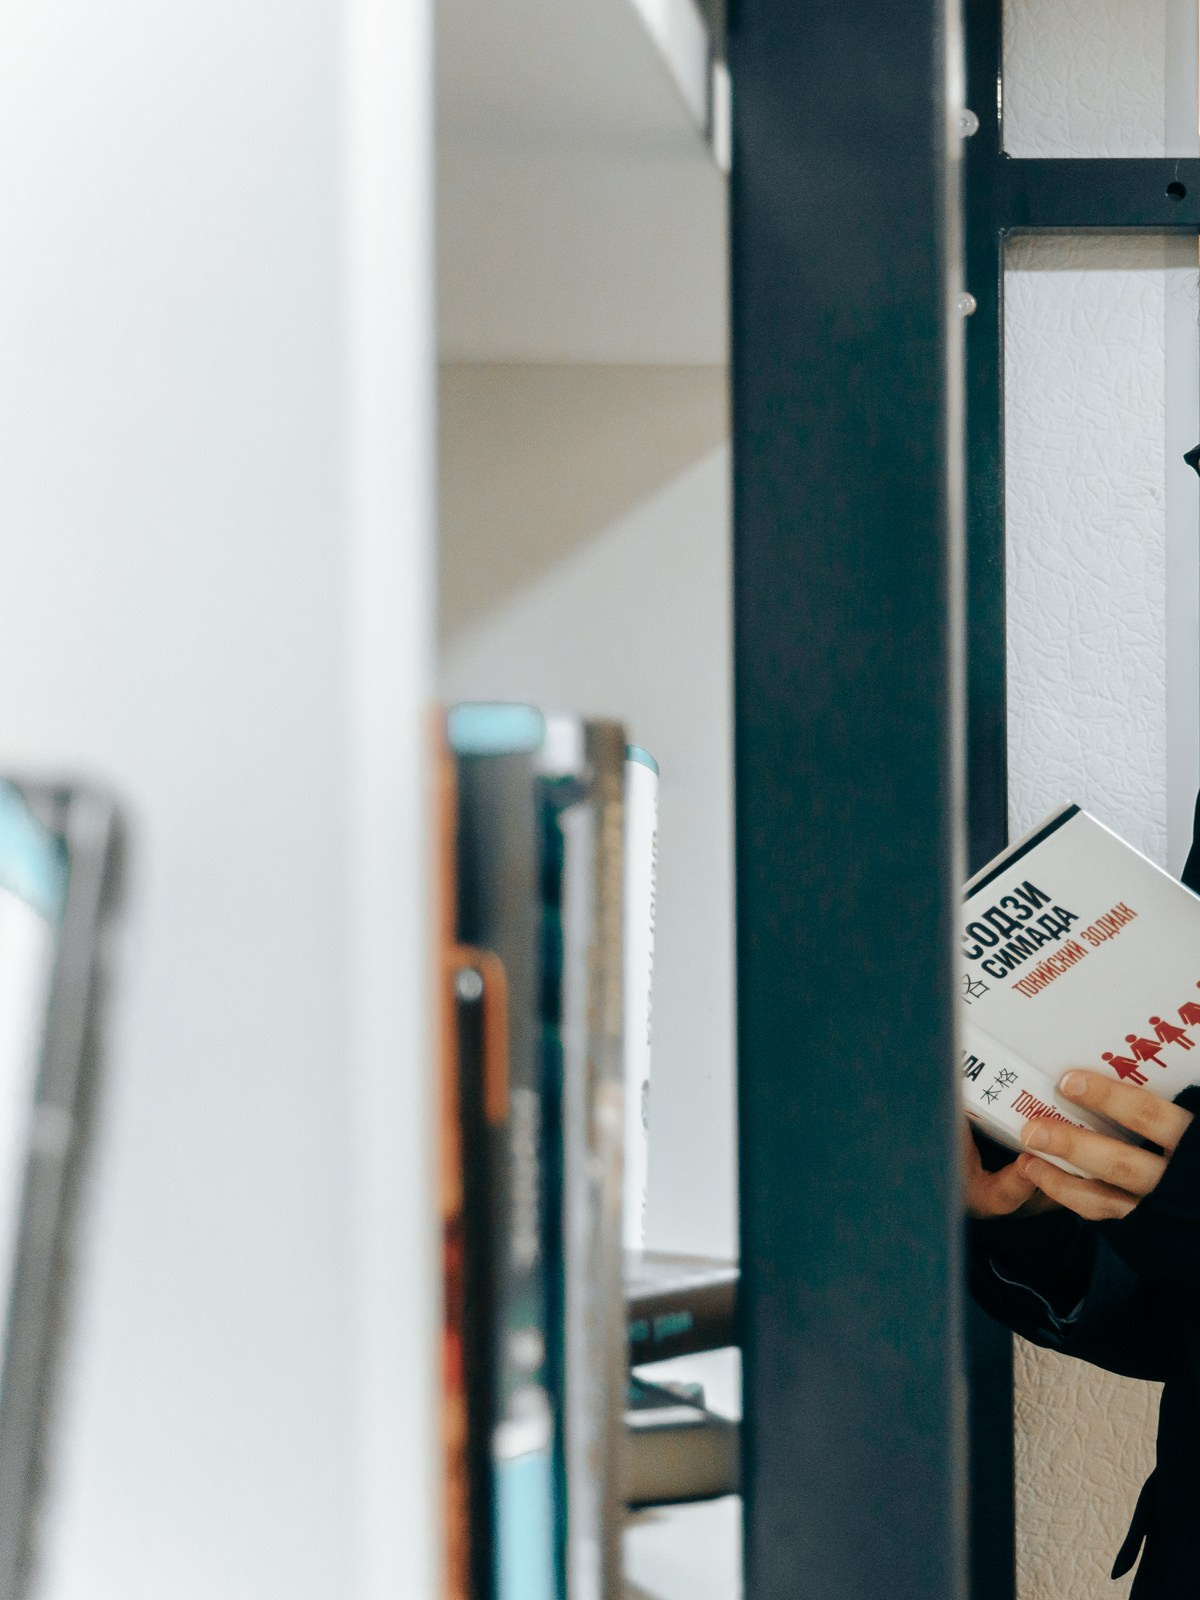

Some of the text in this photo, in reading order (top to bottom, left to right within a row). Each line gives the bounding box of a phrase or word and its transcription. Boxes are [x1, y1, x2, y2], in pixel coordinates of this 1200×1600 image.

[980, 905, 1080, 979] СИМАДА
[1011, 901, 1138, 999] ТОКИЙСКИЙ ЗОДИАК
[980, 1067, 1019, 1105] 本格
